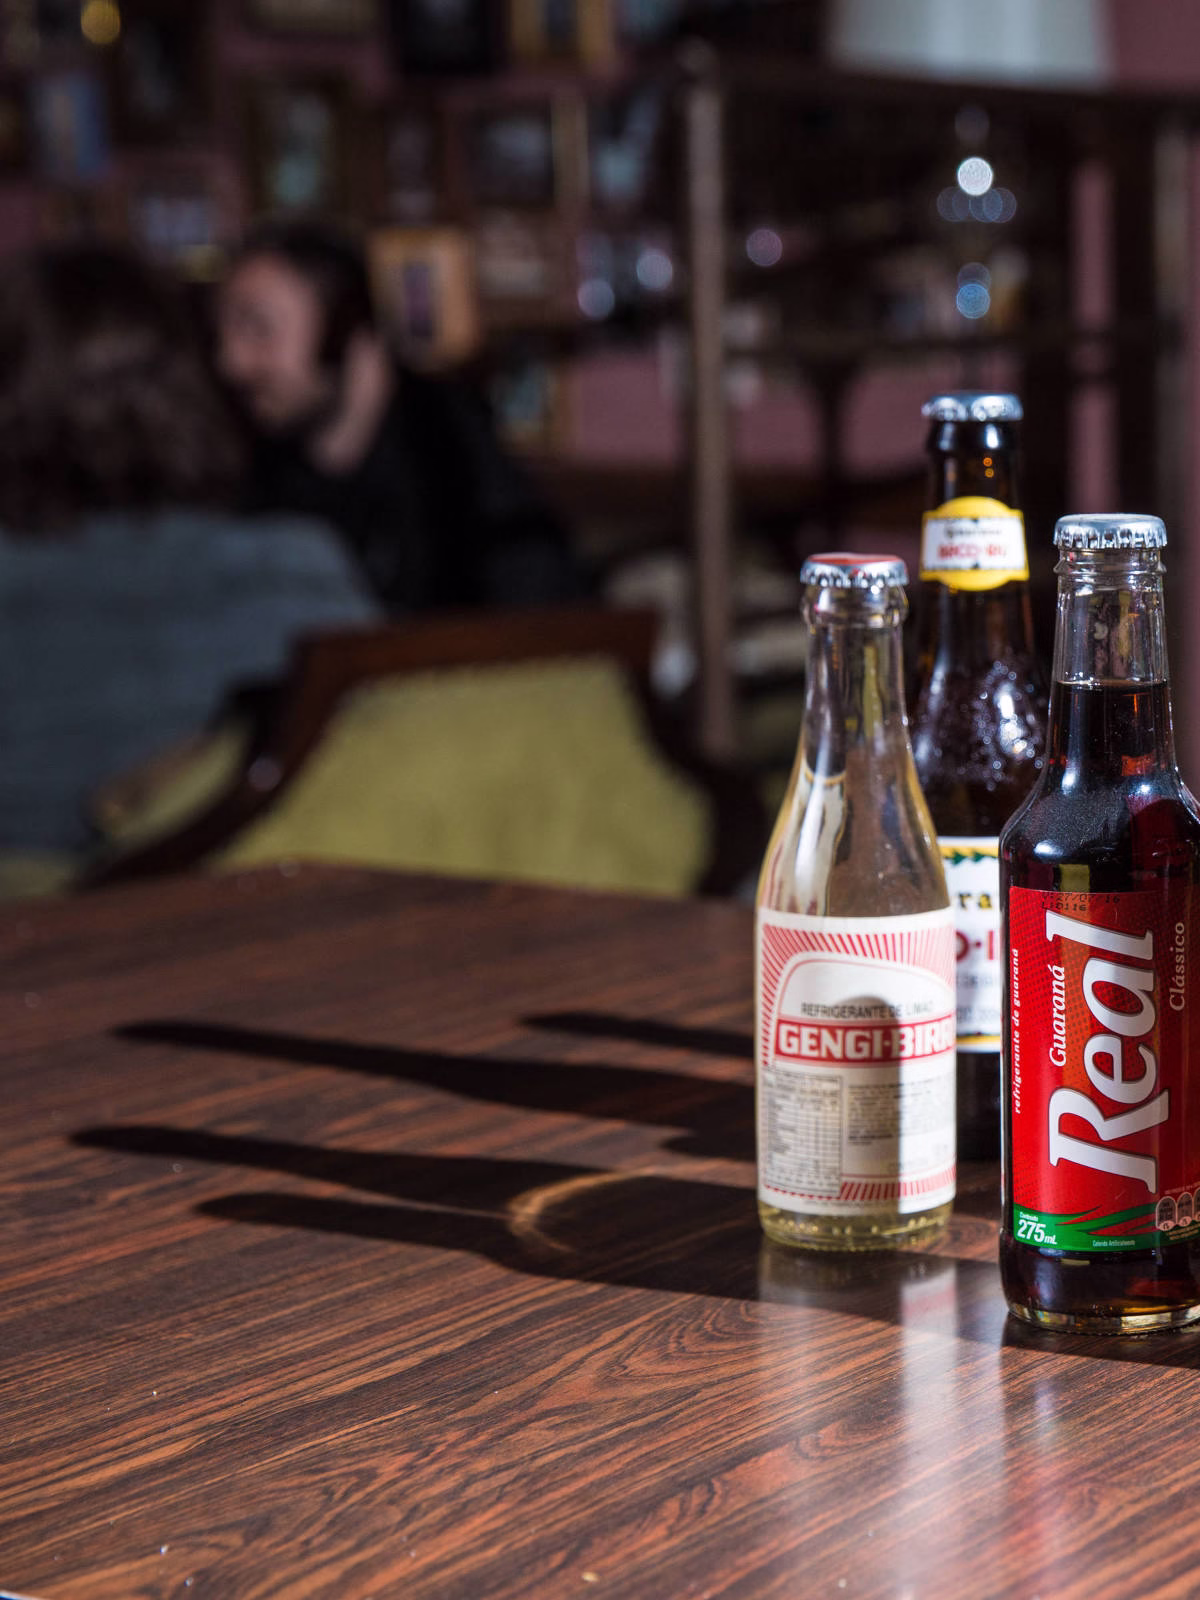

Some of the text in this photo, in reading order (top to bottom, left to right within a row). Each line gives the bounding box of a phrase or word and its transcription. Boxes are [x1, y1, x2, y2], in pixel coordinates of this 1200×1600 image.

[802, 1001, 889, 1018] REFRIGERANTE
[1168, 921, 1186, 1013] Clássico
[1012, 1009, 1020, 1027] de
[1046, 909, 1170, 1194] Real
[1048, 964, 1067, 1067] Guaraná
[1013, 1030, 1022, 1115] refrigerante
